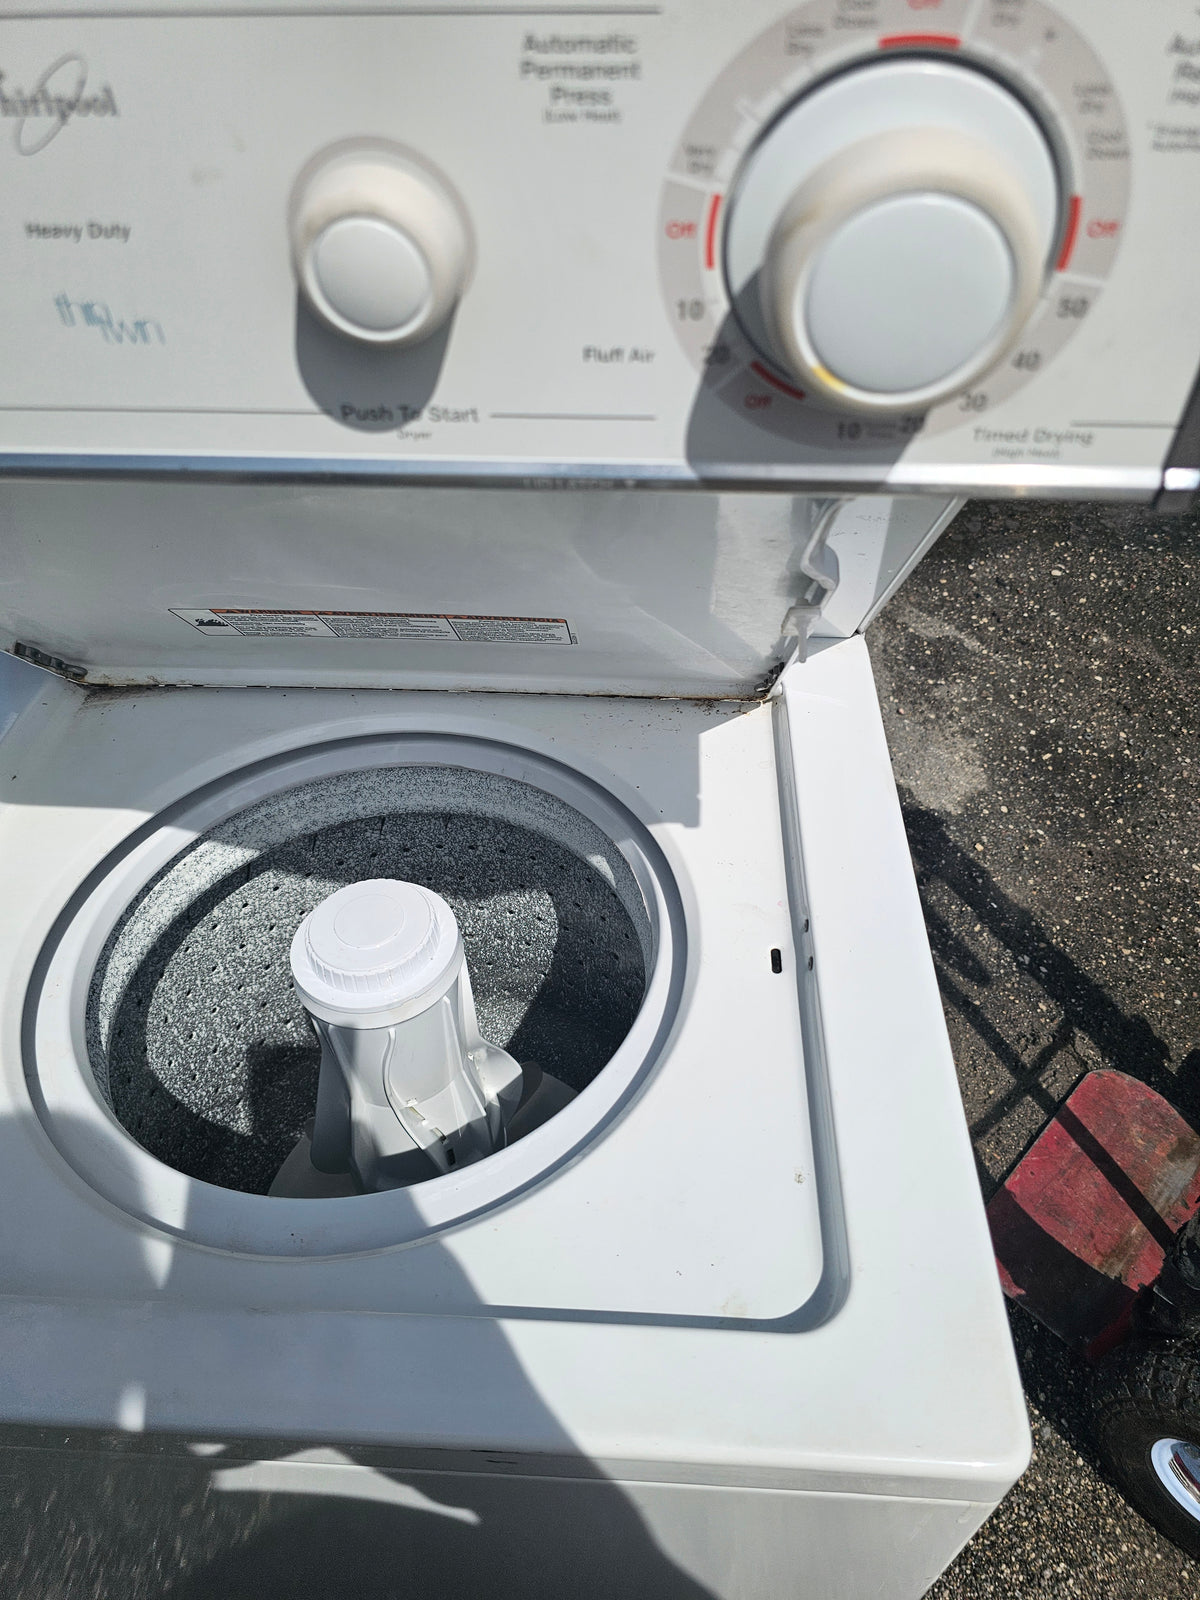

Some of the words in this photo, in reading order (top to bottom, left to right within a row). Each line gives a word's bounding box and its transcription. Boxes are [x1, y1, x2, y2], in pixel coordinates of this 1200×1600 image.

[521, 33, 638, 55] Automatic
[519, 60, 642, 80] Permanent
[25, 221, 83, 244] Heavy
[87, 219, 132, 244] Duty
[665, 221, 697, 240] Off
[1087, 220, 1121, 239] Off
[676, 299, 706, 321] 10
[1057, 297, 1091, 319] 50
[583, 345, 626, 363] Fluff
[628, 346, 656, 363] Air
[1012, 352, 1043, 372] 40
[958, 392, 989, 412] 30
[341, 404, 393, 422] Push
[398, 405, 423, 422] To
[428, 406, 479, 423] Start
[836, 421, 862, 441] 10
